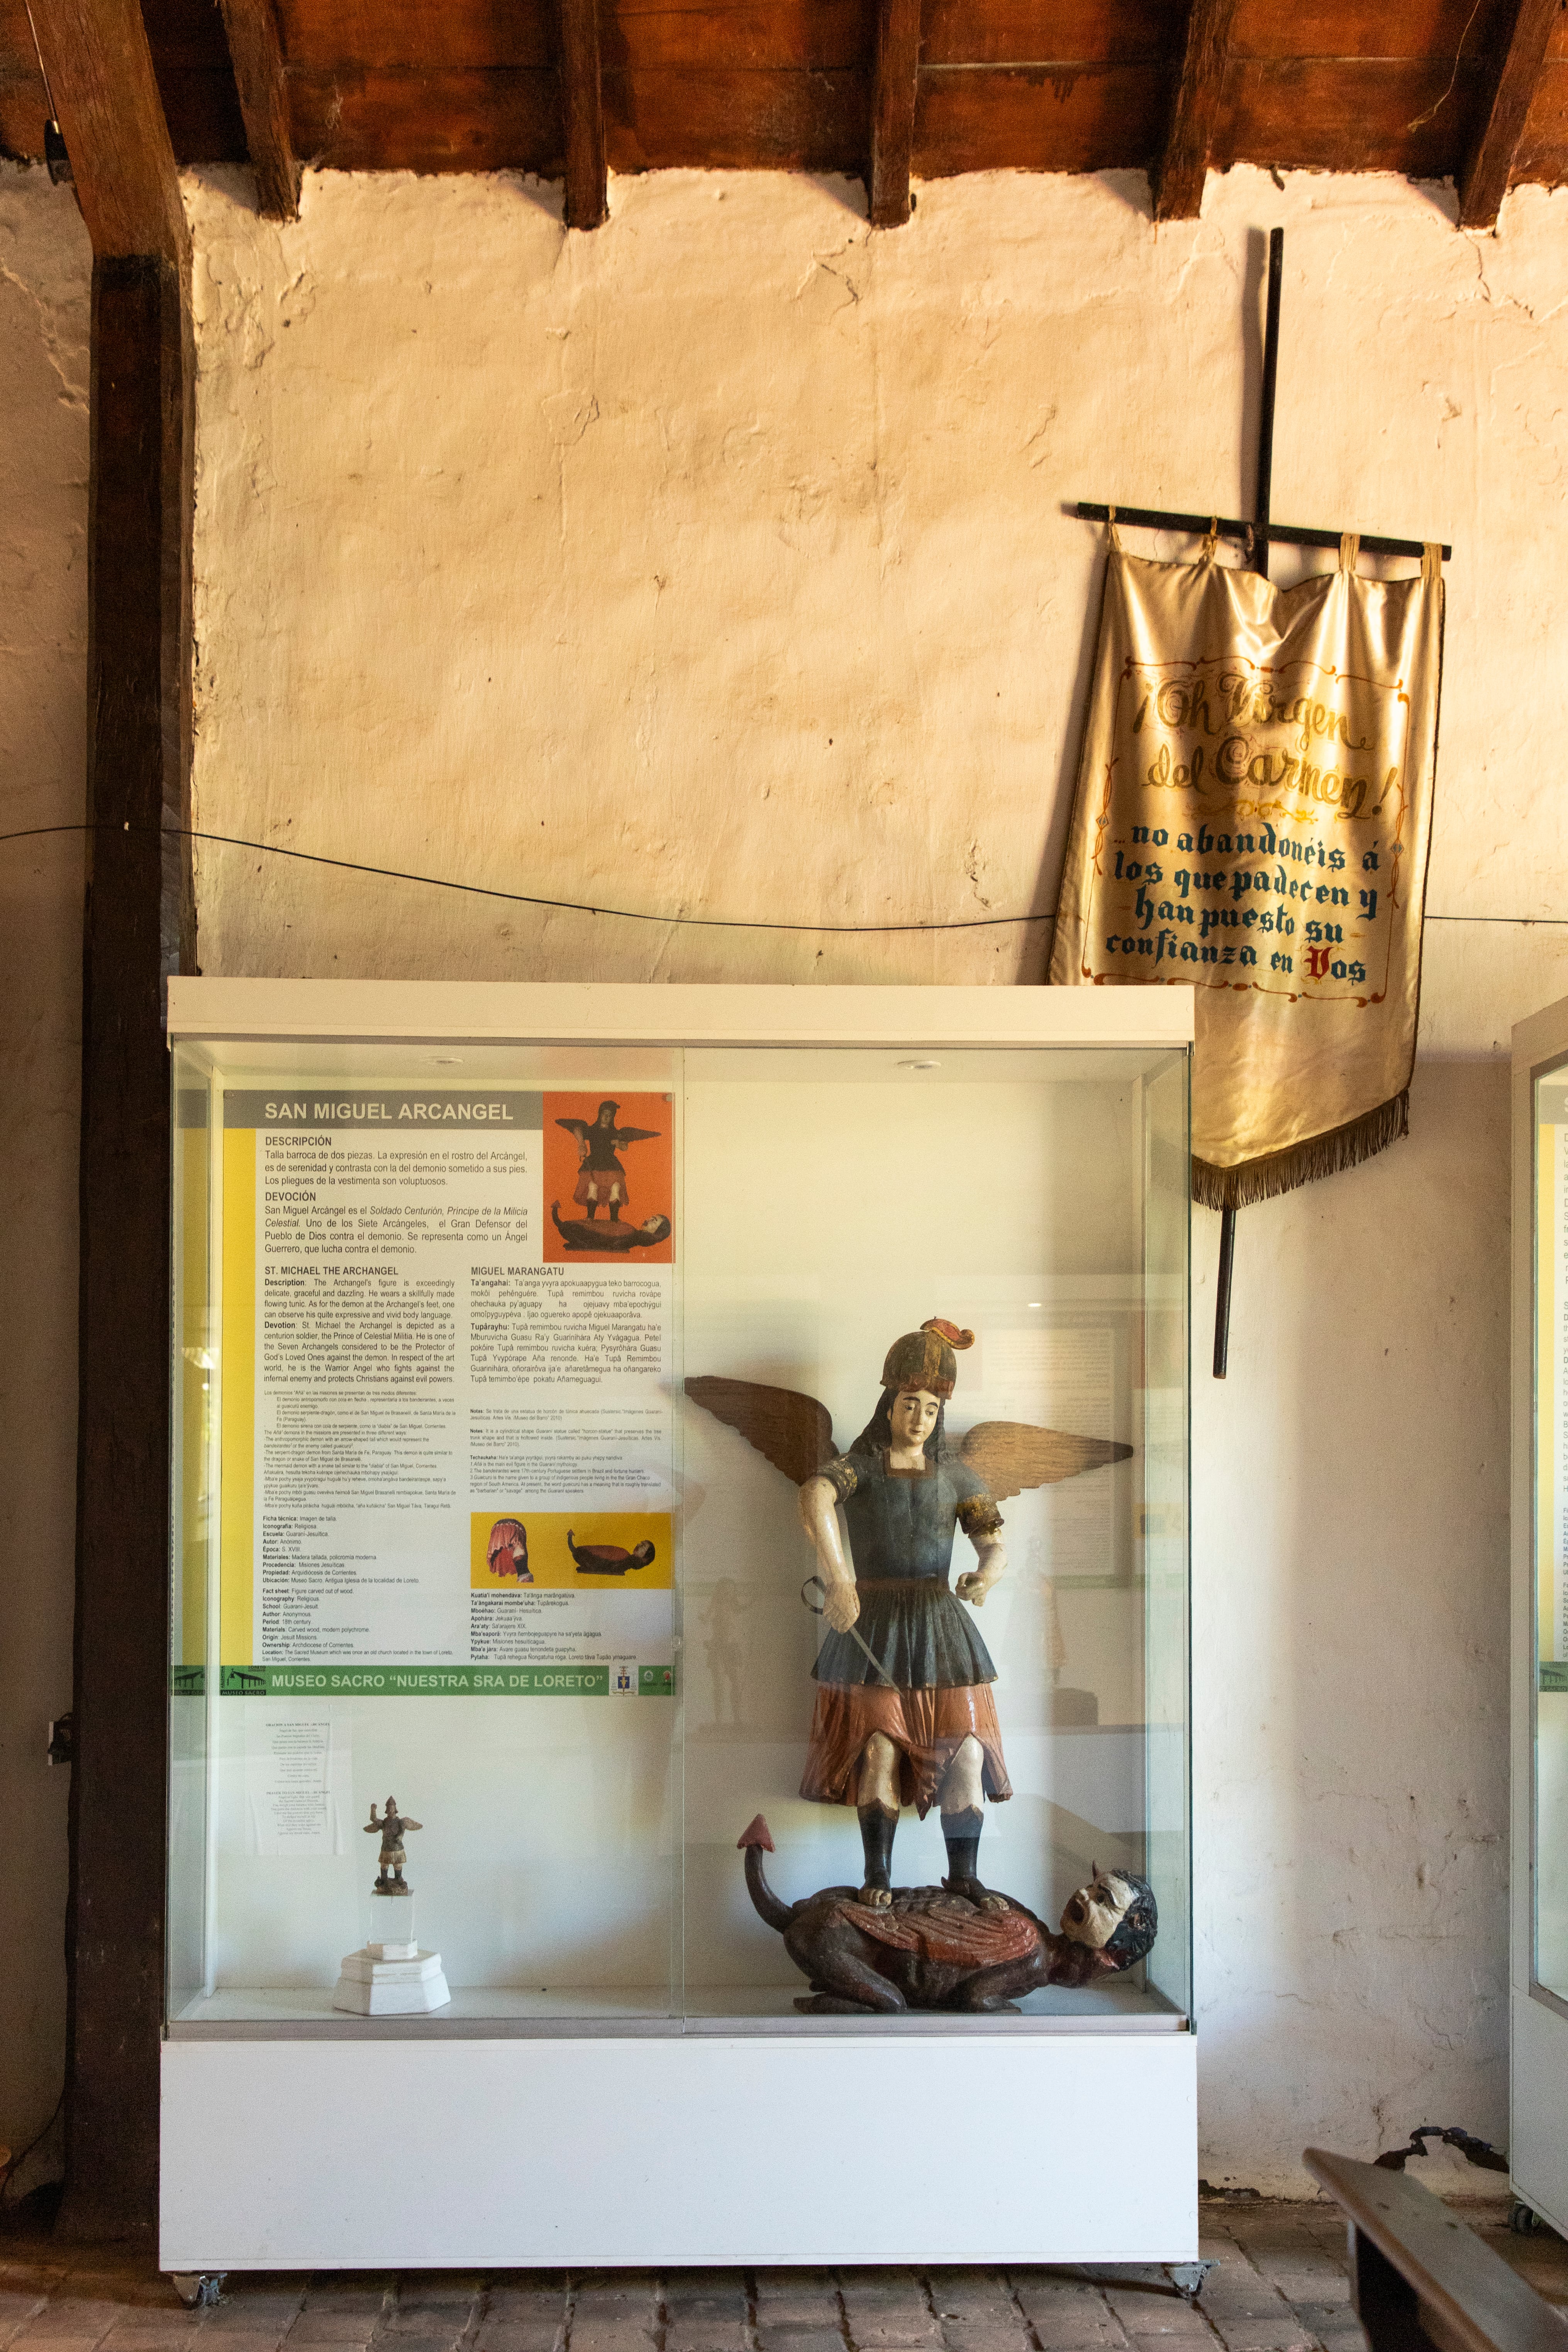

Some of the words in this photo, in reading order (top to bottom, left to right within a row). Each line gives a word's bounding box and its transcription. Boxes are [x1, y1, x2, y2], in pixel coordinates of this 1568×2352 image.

[1142, 742, 1207, 795] del
[1176, 822, 1346, 873] abandonéis
[1114, 850, 1163, 886] los
[1174, 868, 1226, 898] que
[1228, 865, 1351, 906] padecen
[1356, 887, 1378, 921] y
[1134, 884, 1195, 930] han
[1198, 902, 1295, 939] puesto
[1304, 919, 1344, 944] su
[1105, 928, 1258, 969] confianza
[1270, 950, 1295, 974] en
[1304, 946, 1367, 986] Vos
[265, 1103, 306, 1119] SAN
[314, 1103, 392, 1119] MIGUEL
[398, 1103, 514, 1120] ARCANGEL
[265, 1134, 332, 1146] DESCRIPCIÓN
[265, 1150, 285, 1159] Talla
[286, 1150, 317, 1160] barroca
[318, 1150, 329, 1160] de
[330, 1150, 346, 1160] dos
[347, 1150, 375, 1162] piezas.
[377, 1150, 388, 1160] La
[389, 1151, 428, 1162] expresión
[442, 1151, 449, 1160] el
[451, 1152, 474, 1160] rostro
[476, 1151, 488, 1160] del
[490, 1151, 527, 1162] Arcángel,
[276, 1163, 286, 1172] de
[288, 1163, 327, 1173] serenidad
[328, 1165, 334, 1175] y
[335, 1163, 372, 1173] contrasta
[390, 1163, 397, 1173] la
[398, 1163, 411, 1173] del
[412, 1164, 447, 1173] demonio
[448, 1164, 484, 1173] sometido
[509, 1166, 527, 1175] pies.
[265, 1176, 280, 1185] Los
[281, 1176, 315, 1187] pliegues
[316, 1175, 327, 1185] de
[328, 1176, 336, 1185] la
[337, 1177, 380, 1185] vestimenta
[399, 1176, 447, 1187] voluptuosos.
[265, 1190, 316, 1202] DEVOCIÓN
[264, 1205, 281, 1214] San
[283, 1205, 309, 1217] Miguel
[310, 1205, 346, 1217] Arcángel
[348, 1207, 358, 1215] es
[359, 1206, 367, 1215] el
[370, 1205, 402, 1215] Soldado
[404, 1206, 444, 1216] Centurión,
[481, 1207, 492, 1216] de
[493, 1207, 501, 1215] la
[503, 1207, 528, 1216] Milicia
[265, 1218, 300, 1228] Celestial.
[305, 1218, 323, 1228] Uno
[326, 1218, 337, 1228] de
[341, 1218, 353, 1228] los
[358, 1218, 378, 1228] Siete
[382, 1218, 429, 1230] Arcángeles,
[438, 1219, 446, 1228] el
[451, 1219, 470, 1228] Gran
[475, 1219, 511, 1228] Defensor
[515, 1220, 527, 1228] del
[264, 1231, 293, 1240] Pueblo
[295, 1231, 306, 1241] de
[309, 1231, 327, 1241] Dios
[329, 1231, 354, 1241] contra
[357, 1231, 365, 1241] el
[367, 1231, 404, 1241] demonio.
[407, 1231, 419, 1241] Se
[421, 1233, 464, 1243] representa
[505, 1231, 527, 1243] Ángel
[264, 1243, 302, 1254] Guerrero,
[304, 1246, 320, 1255] que
[321, 1244, 343, 1253] lucha
[344, 1245, 370, 1253] contra
[371, 1245, 379, 1253] el
[380, 1245, 417, 1253] demonio.
[265, 1266, 278, 1275] ST.
[281, 1266, 321, 1275] MICHAEL
[322, 1266, 341, 1275] THE
[342, 1266, 399, 1275] ARCHANGEL
[471, 1266, 505, 1276] MIGUEL
[507, 1267, 564, 1276] MARANGATU
[264, 1278, 307, 1287] Description:
[314, 1278, 327, 1286] The
[378, 1279, 397, 1288] figure
[416, 1279, 455, 1288] exceedingly
[315, 1321, 341, 1329] Michael
[359, 1321, 393, 1331] Archangel
[406, 1321, 434, 1331] depicted
[271, 1674, 327, 1687] MUSEO
[330, 1674, 385, 1687] SACRO
[389, 1675, 469, 1687] SACRO
[509, 1675, 529, 1687] SRA
